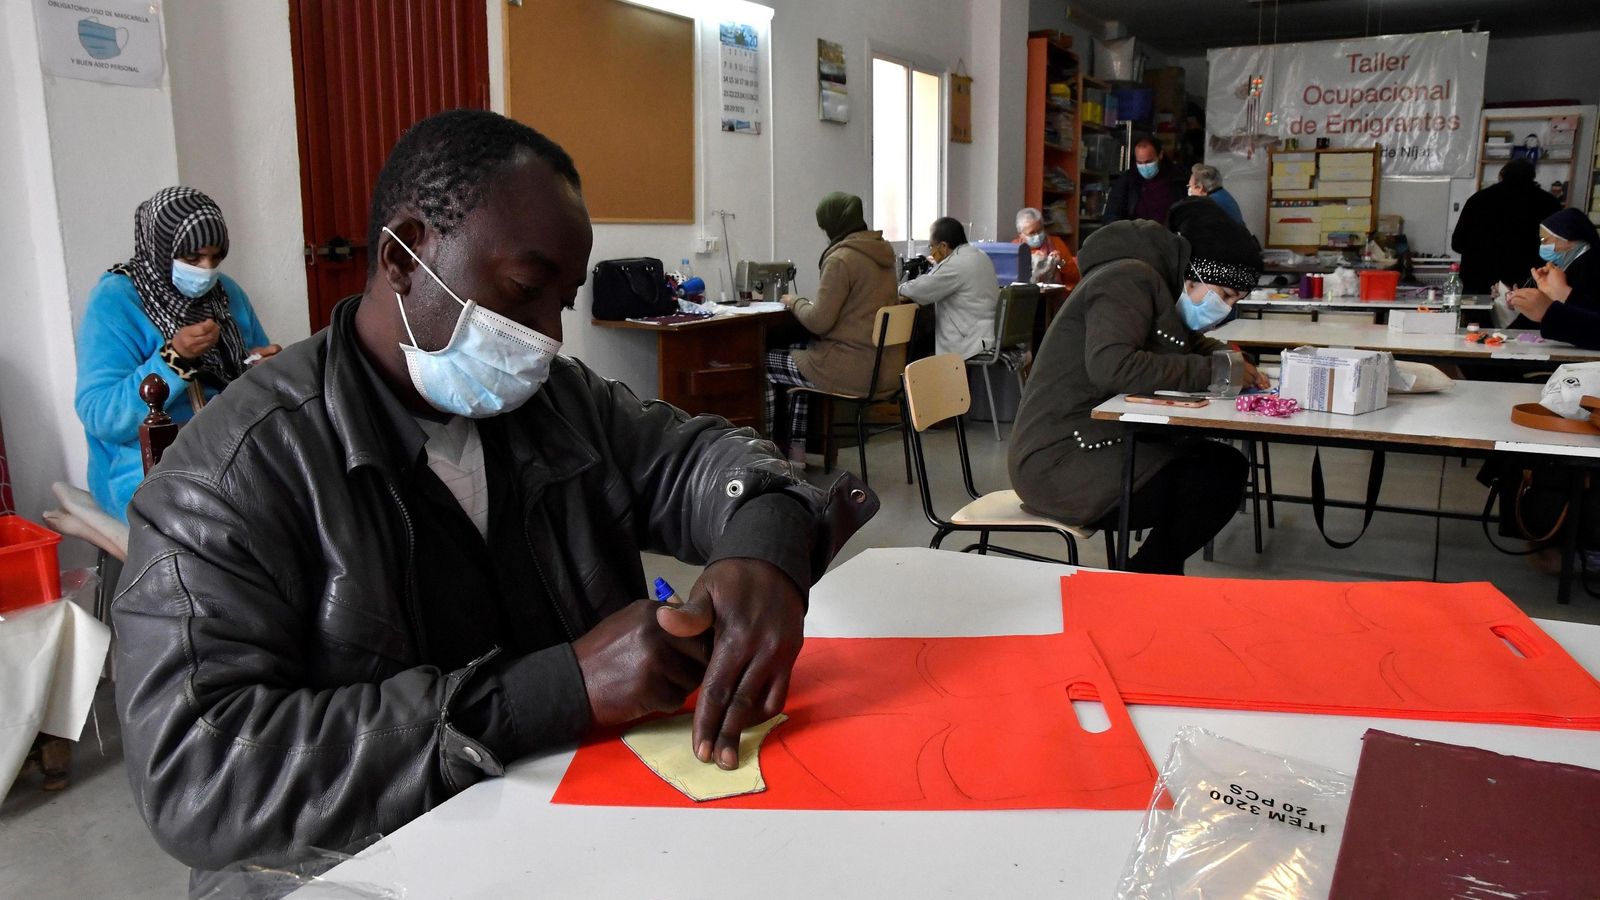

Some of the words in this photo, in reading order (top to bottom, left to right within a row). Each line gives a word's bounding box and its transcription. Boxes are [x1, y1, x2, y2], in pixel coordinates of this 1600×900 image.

[47, 0, 90, 13] OBLIGATORIO
[90, 8, 104, 16] USO
[114, 12, 150, 23] MASCARILLA
[76, 59, 93, 67] BUEN
[110, 63, 139, 73] PERSONAL
[1347, 52, 1410, 73] Taller
[1303, 79, 1451, 106] Ocupacional
[1290, 116, 1317, 135] de
[1326, 111, 1461, 138] Emigrantes
[1209, 790, 1261, 815] 3200
[1229, 783, 1275, 808] PCS
[1282, 803, 1308, 816] 20
[1268, 810, 1326, 834] ITEM
